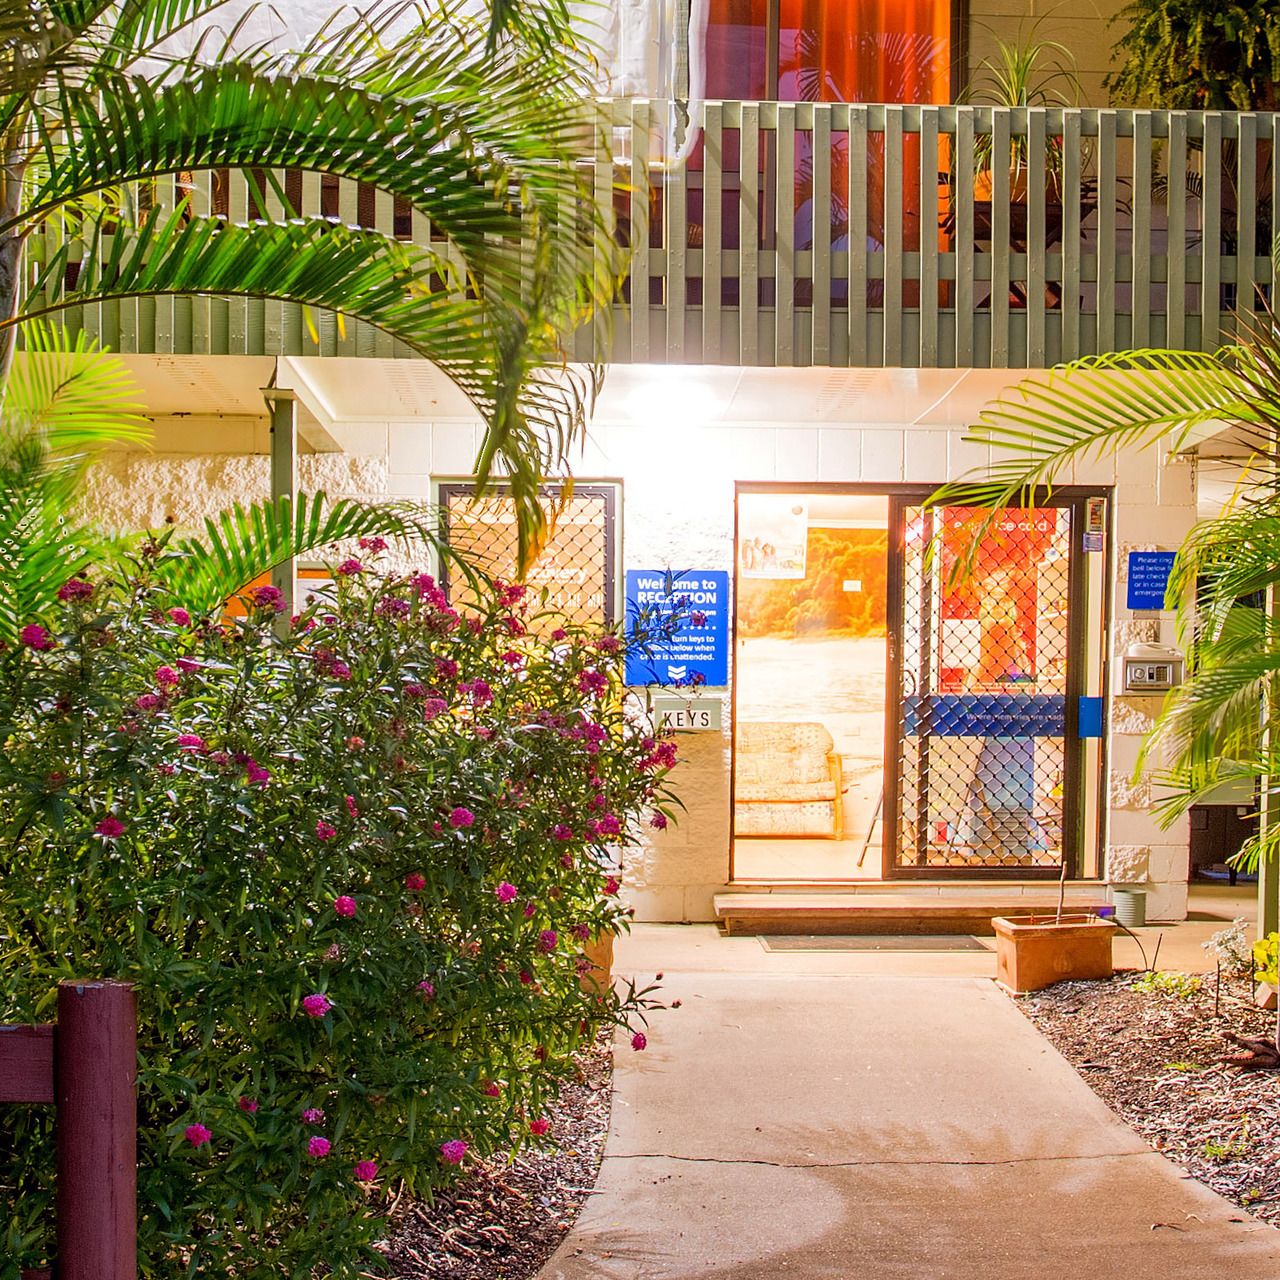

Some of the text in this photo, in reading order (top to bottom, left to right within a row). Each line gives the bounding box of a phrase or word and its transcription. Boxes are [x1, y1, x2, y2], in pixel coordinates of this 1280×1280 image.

[637, 578, 716, 590] Welome to
[689, 635, 705, 644] keys
[664, 711, 709, 727] KEYS
